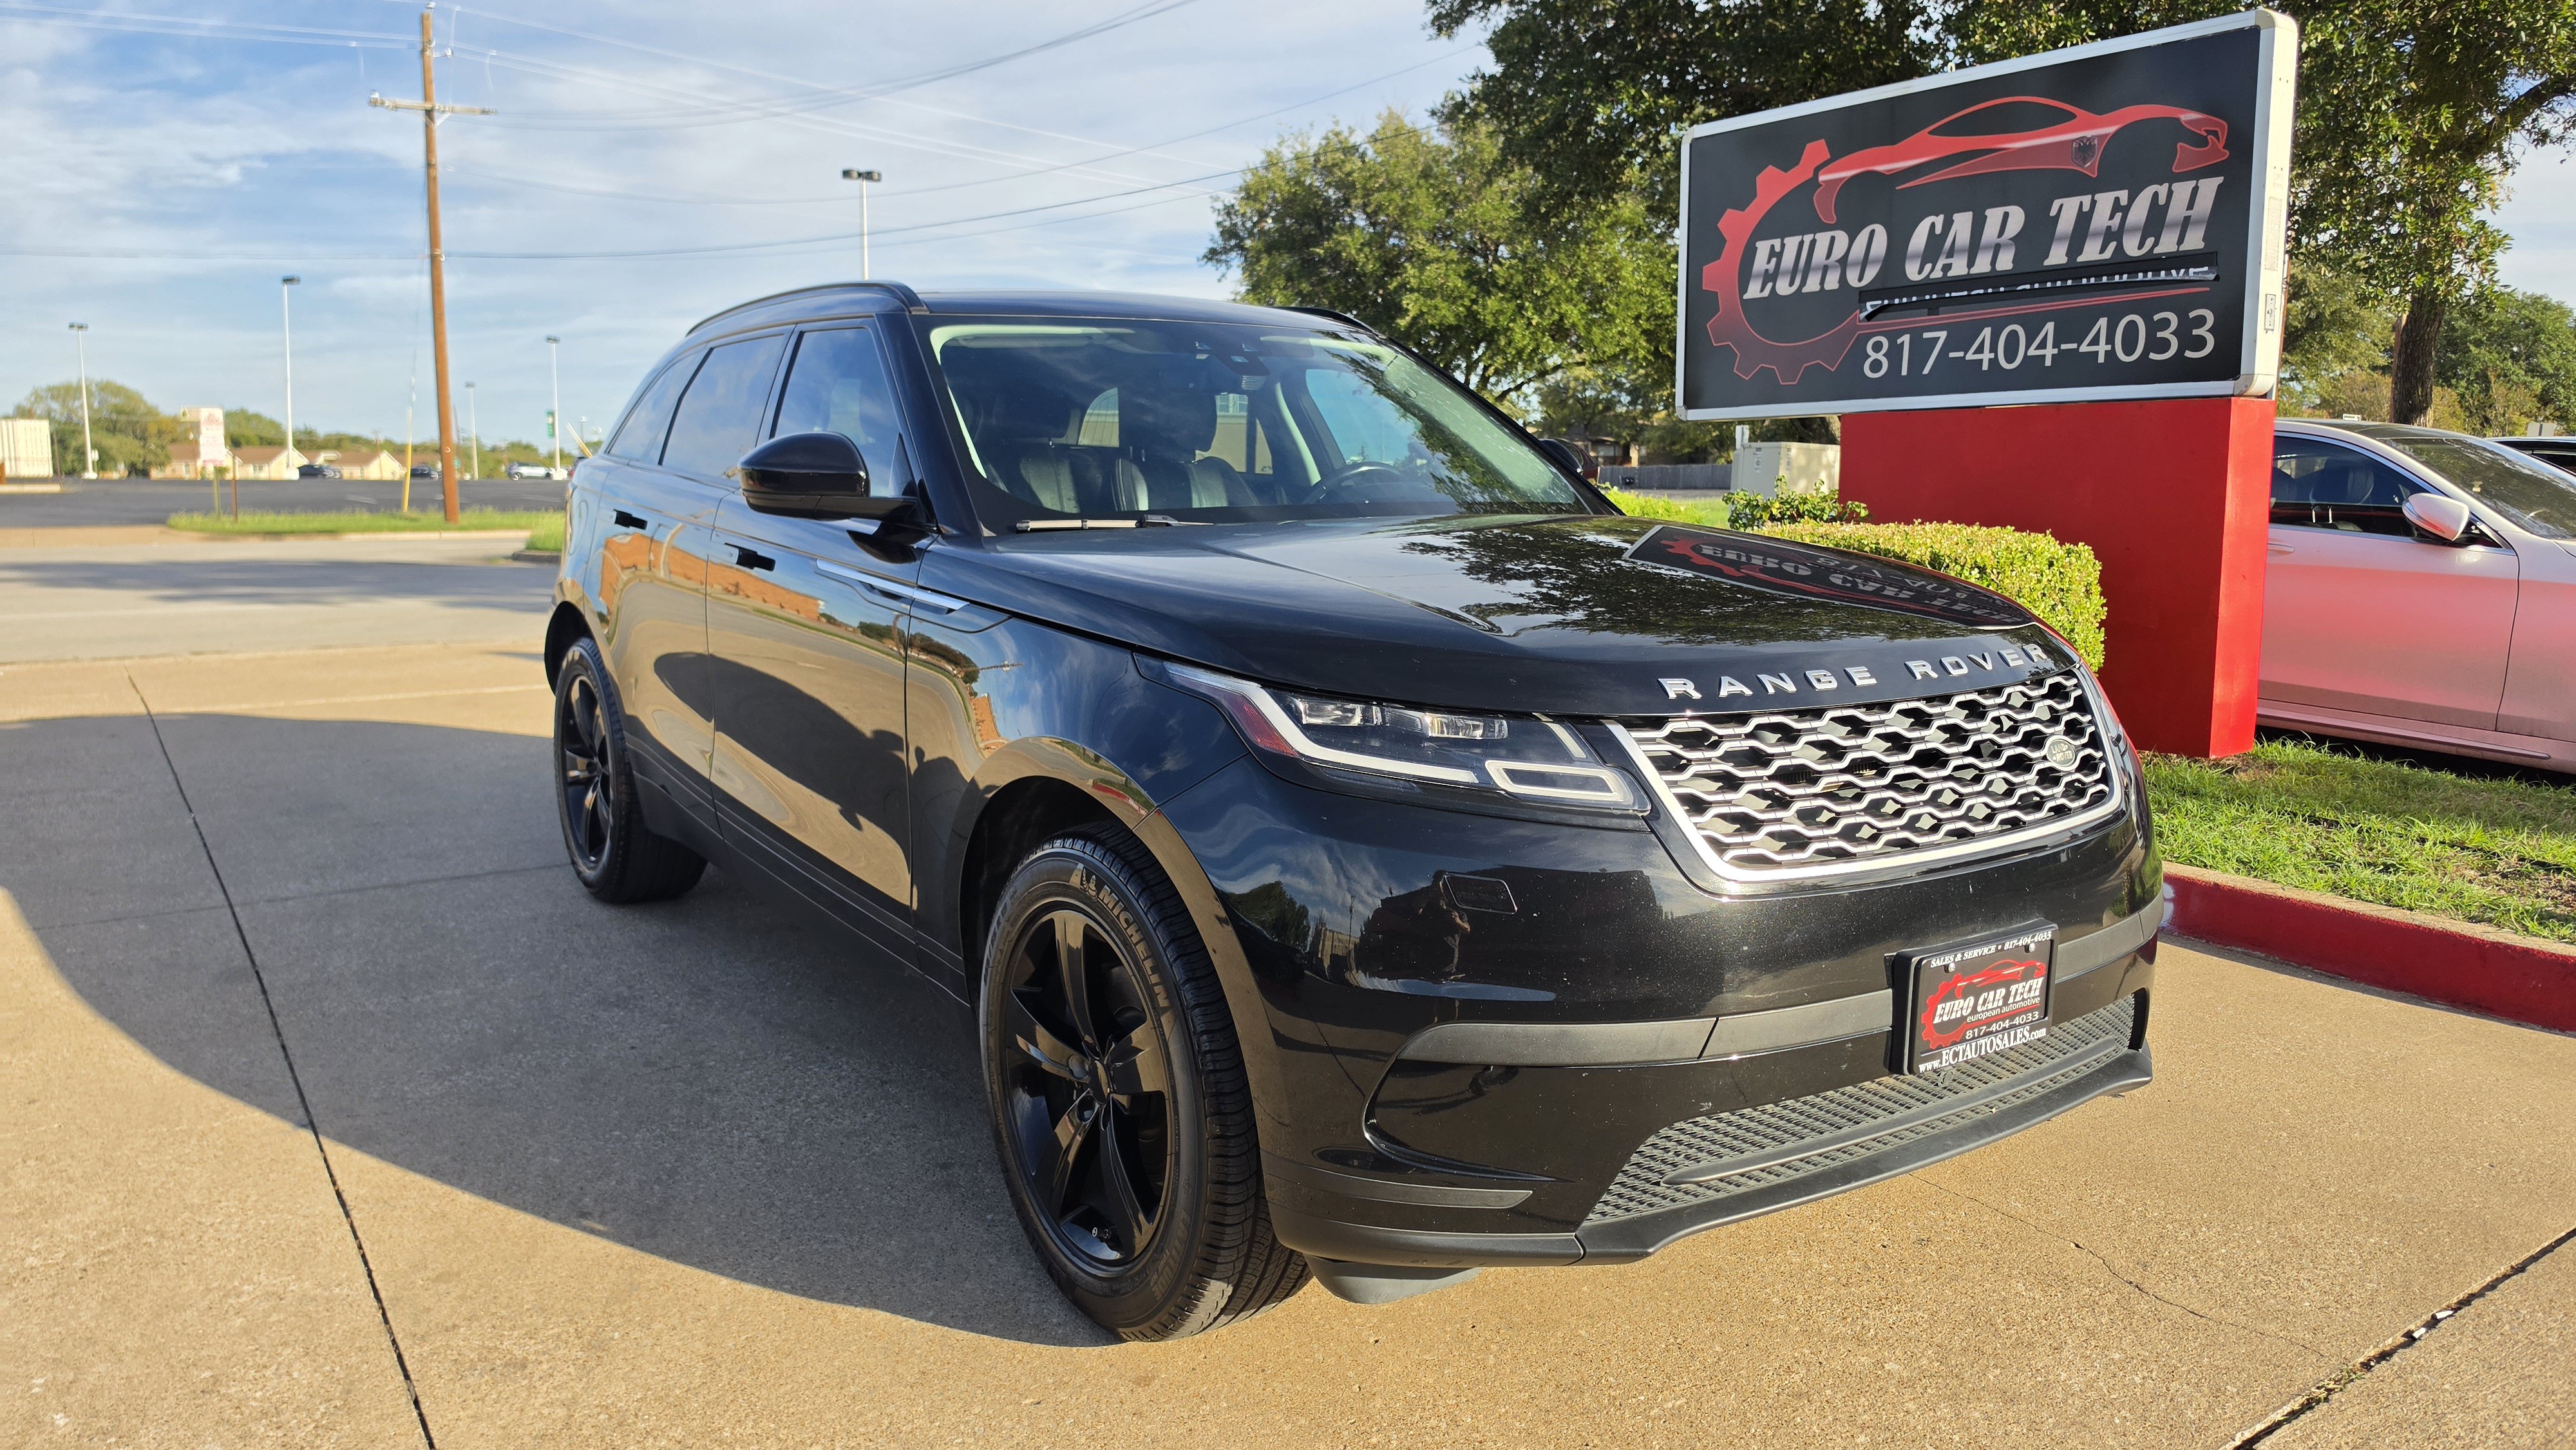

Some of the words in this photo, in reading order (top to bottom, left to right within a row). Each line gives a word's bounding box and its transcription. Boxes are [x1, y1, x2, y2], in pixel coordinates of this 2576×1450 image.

[1743, 223, 1887, 299] EURO
[1905, 206, 2025, 282] CAR
[2043, 176, 2224, 266] TECH
[1863, 309, 2215, 379] 817-404-4033
[1658, 666, 1877, 699] RANGE
[1904, 644, 2047, 681] ROVER
[2050, 743, 2067, 753] LAND
[2055, 751, 2072, 762] ROVER
[1099, 885, 1170, 1008] MICHELIN
[1931, 956, 1955, 968] SALES
[1955, 953, 1962, 963] &
[1963, 945, 1996, 960] SERVICE
[2003, 930, 2052, 950] 817-404-4033
[1933, 996, 1975, 1024] EURO
[1977, 988, 2006, 1012] CAR
[2008, 977, 2044, 1004] TECH
[1967, 1008, 2000, 1022] european
[2002, 997, 2040, 1013] automotive
[1965, 1011, 2039, 1039] 817-404-4033
[1918, 1026, 2047, 1073] www.ECTAUTOSALES.com
